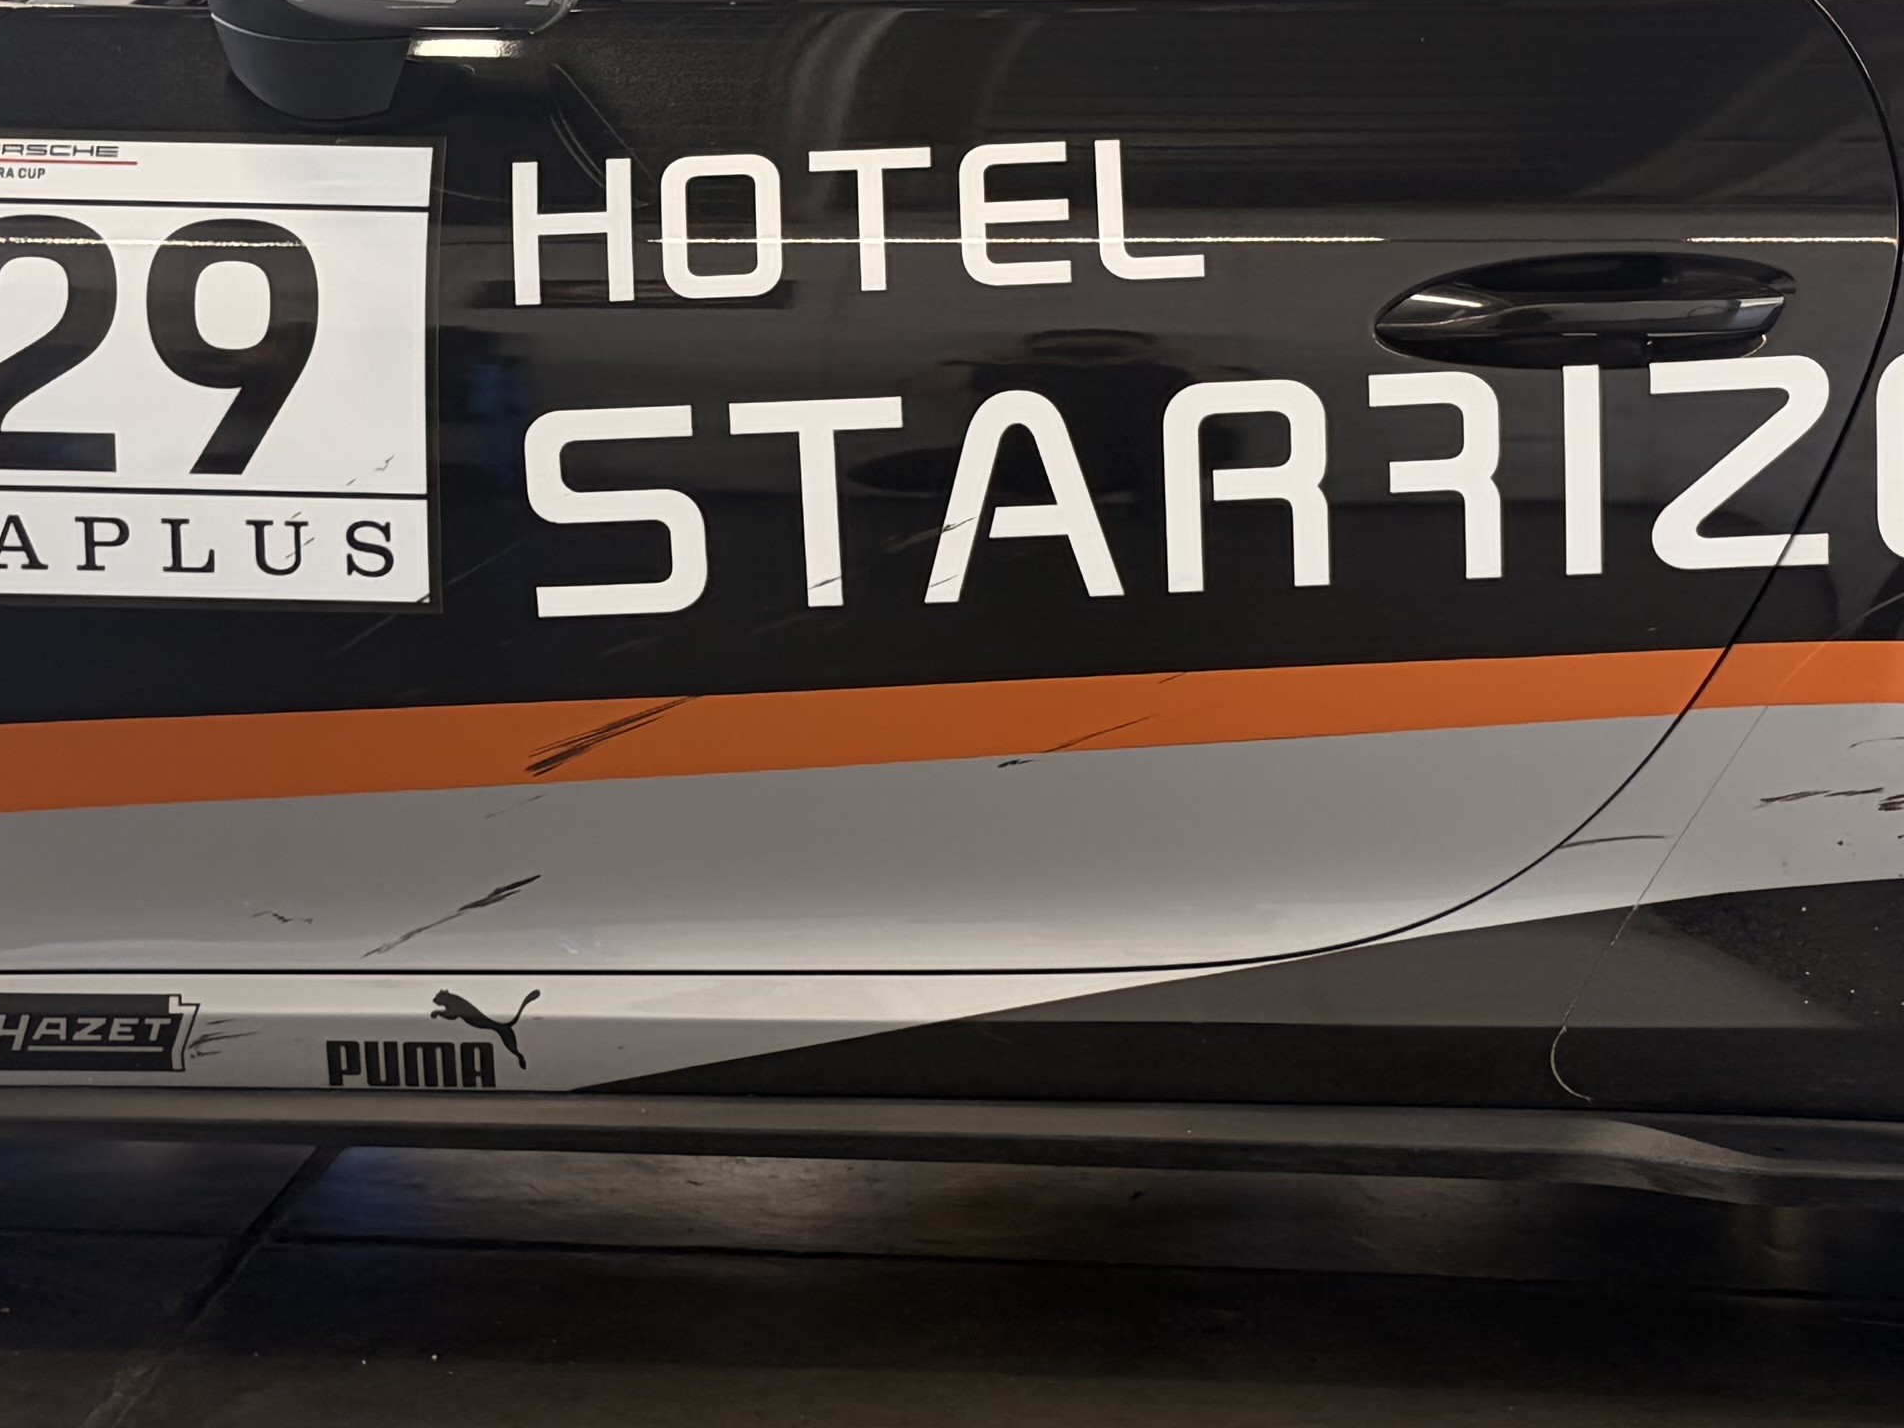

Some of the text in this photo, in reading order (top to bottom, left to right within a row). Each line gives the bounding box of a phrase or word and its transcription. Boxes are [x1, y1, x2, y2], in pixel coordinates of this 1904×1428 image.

[18, 167, 46, 179] CUP
[512, 139, 1205, 306] HOTEL
[327, 1040, 496, 1088] PUMA
